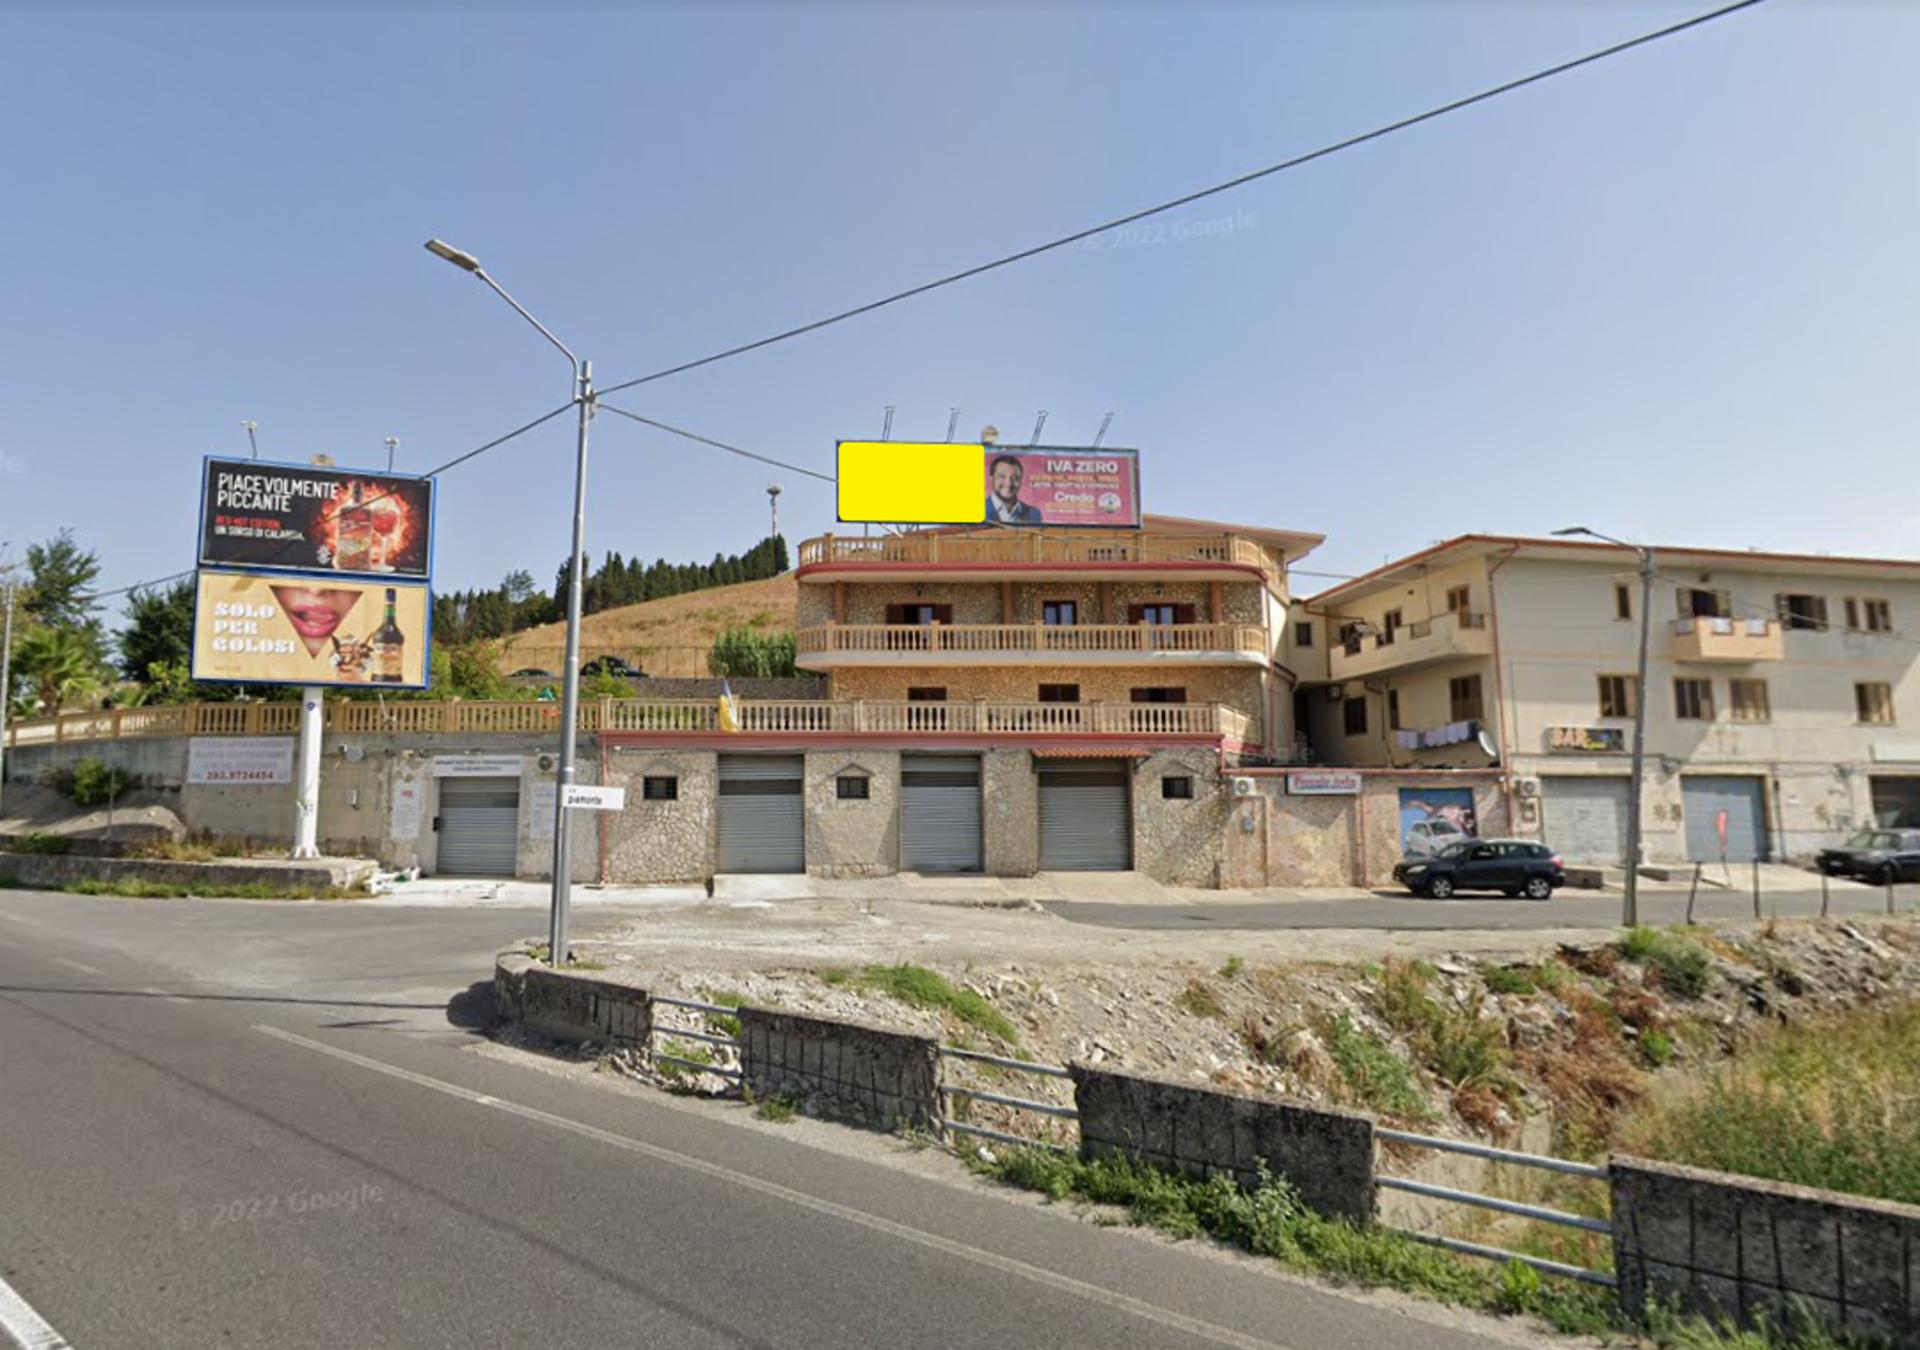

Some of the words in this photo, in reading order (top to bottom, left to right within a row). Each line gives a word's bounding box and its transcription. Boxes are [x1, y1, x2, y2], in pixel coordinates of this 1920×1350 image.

[1047, 460, 1073, 473] IVA
[1076, 461, 1119, 474] ZERO
[218, 472, 339, 500] PIACEVOLMENTE
[217, 489, 292, 512] PICCANTE
[1054, 491, 1095, 503] Credo
[214, 602, 275, 619] SOLO
[214, 620, 259, 635] PER
[212, 637, 297, 654] GOLOSI
[1551, 728, 1588, 748] BAR
